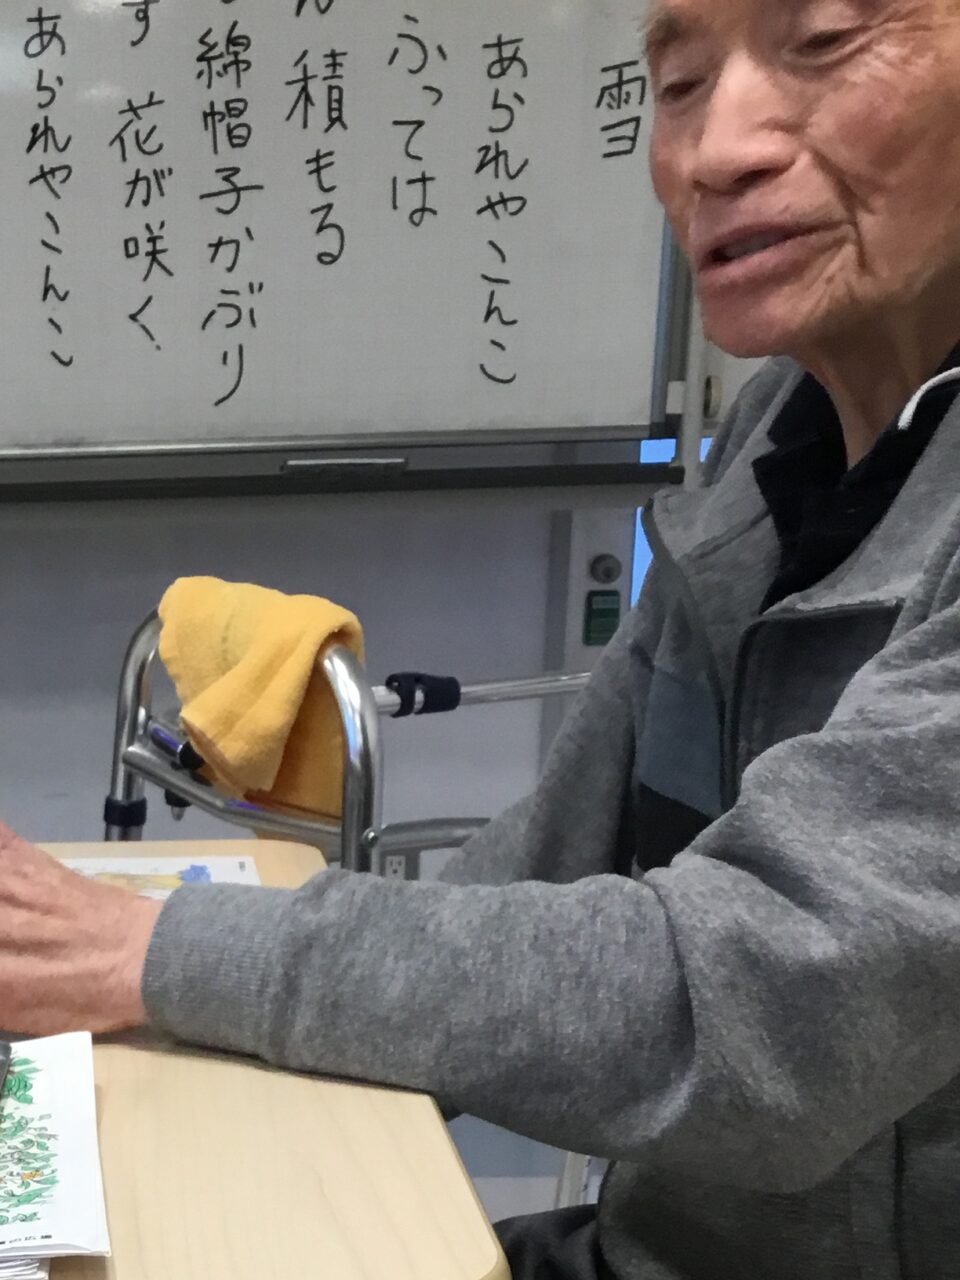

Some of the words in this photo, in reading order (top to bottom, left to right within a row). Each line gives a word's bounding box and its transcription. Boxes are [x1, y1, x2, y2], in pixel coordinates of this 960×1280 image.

[23, 7, 74, 368] あられやこんこ
[196, 20, 265, 407] 綿帽子かぶり
[284, 48, 349, 266] 積もる
[387, 14, 448, 227] ふっては
[476, 34, 529, 384] あられやこんこ
[596, 60, 646, 159] 雪
